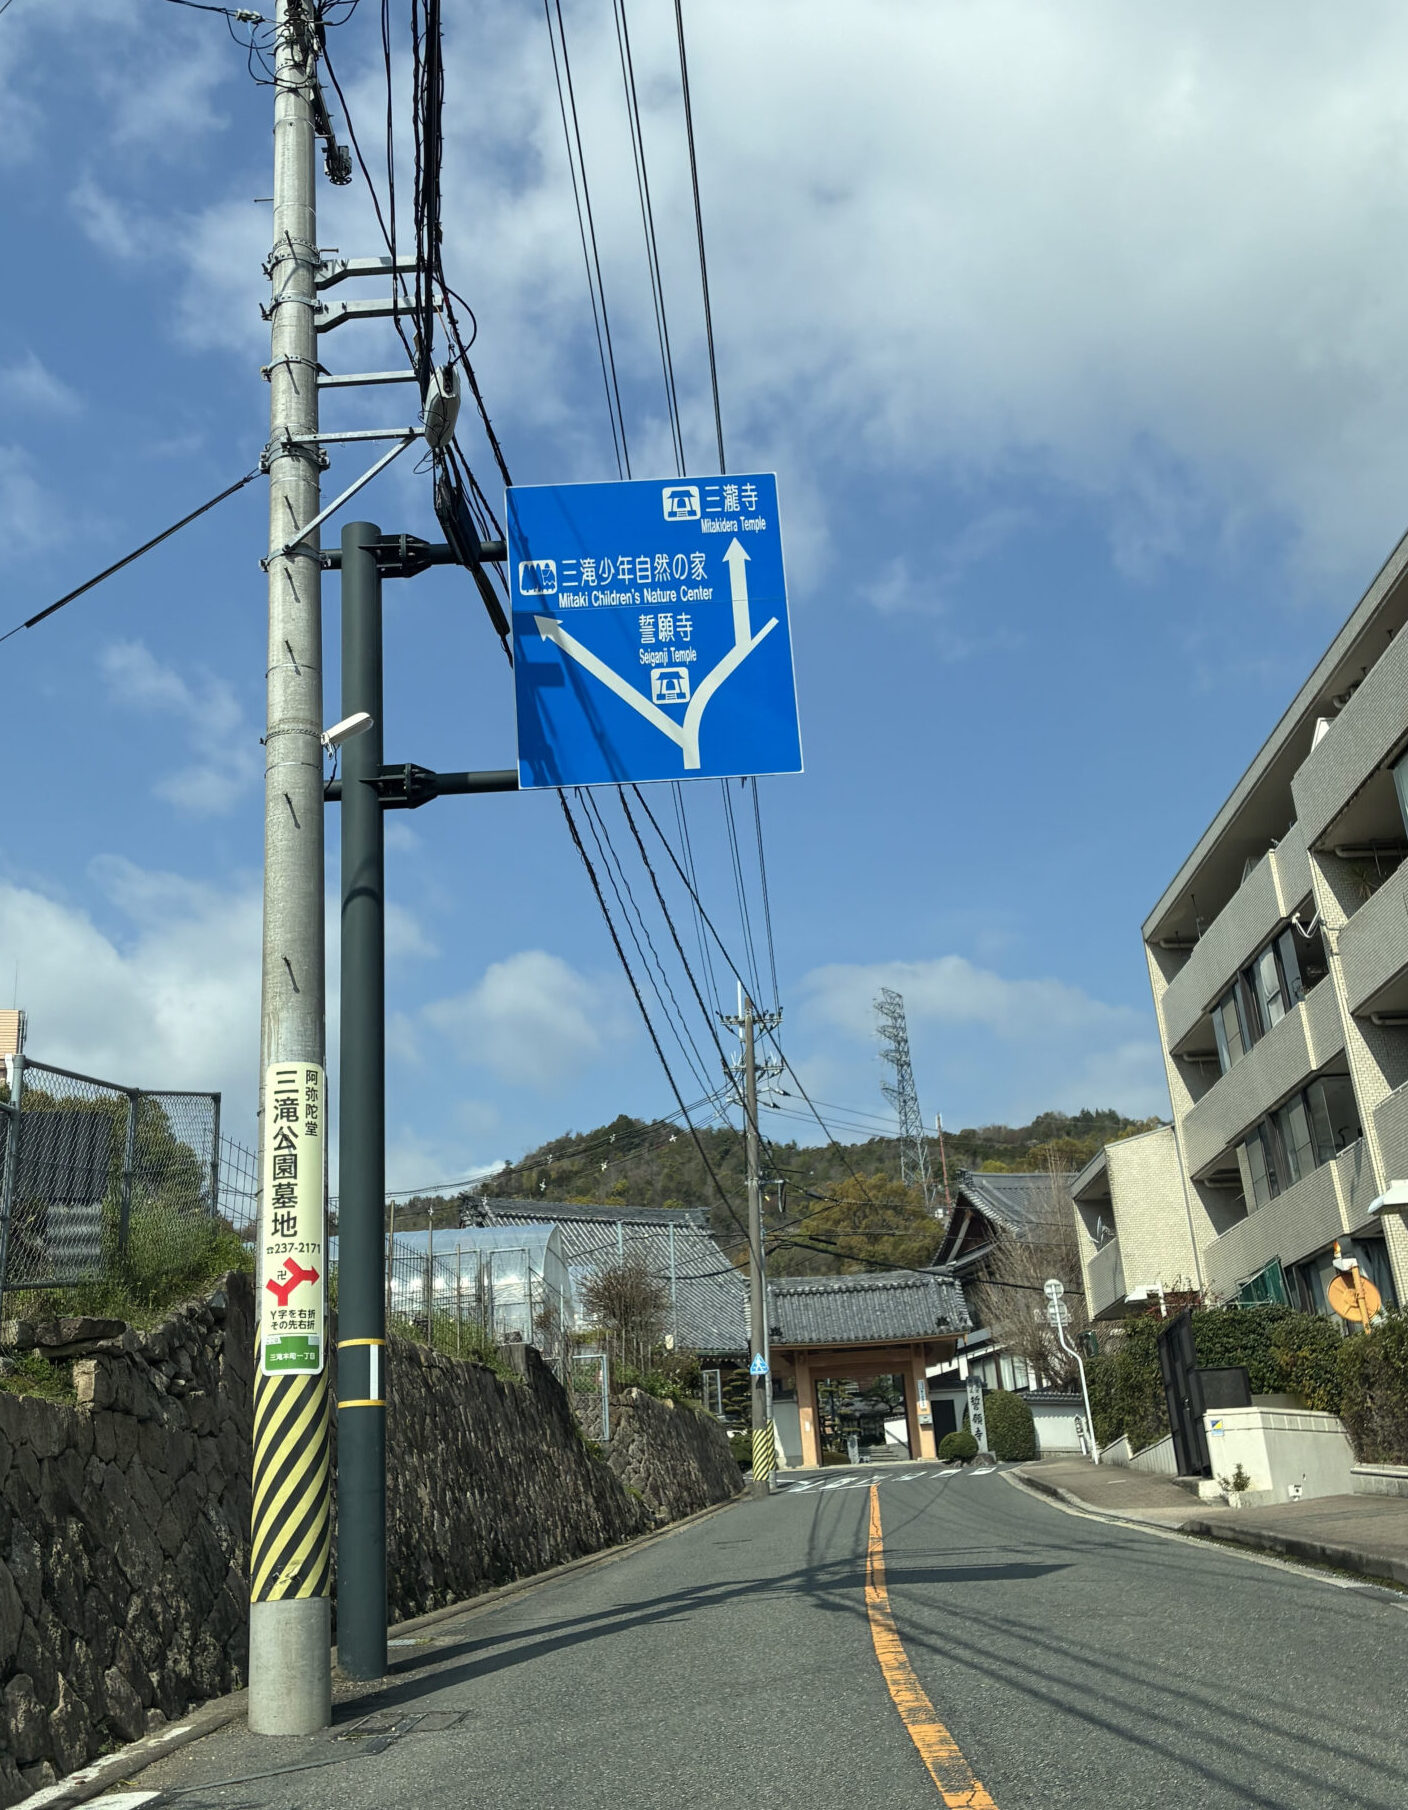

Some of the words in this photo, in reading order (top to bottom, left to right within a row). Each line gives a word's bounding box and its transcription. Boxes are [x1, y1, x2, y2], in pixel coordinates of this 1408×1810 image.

[704, 482, 758, 512] 三瀧寺
[700, 516, 738, 533] Mitakidera
[739, 514, 767, 534] Temple
[561, 551, 708, 587] 三滝少年自然の家
[558, 590, 589, 608] Mitaki
[591, 588, 641, 606] Children's
[643, 587, 677, 603] Nature
[680, 585, 714, 601] Center
[638, 612, 693, 644] 誓願寺
[638, 647, 669, 667] Seiganji
[670, 646, 697, 663] Temple
[304, 1069, 319, 1137] 阿弥陀堂
[270, 1069, 300, 1238] 三滝公園墓地
[274, 1242, 321, 1254] 237-2171
[270, 1320, 315, 1331] その先右折
